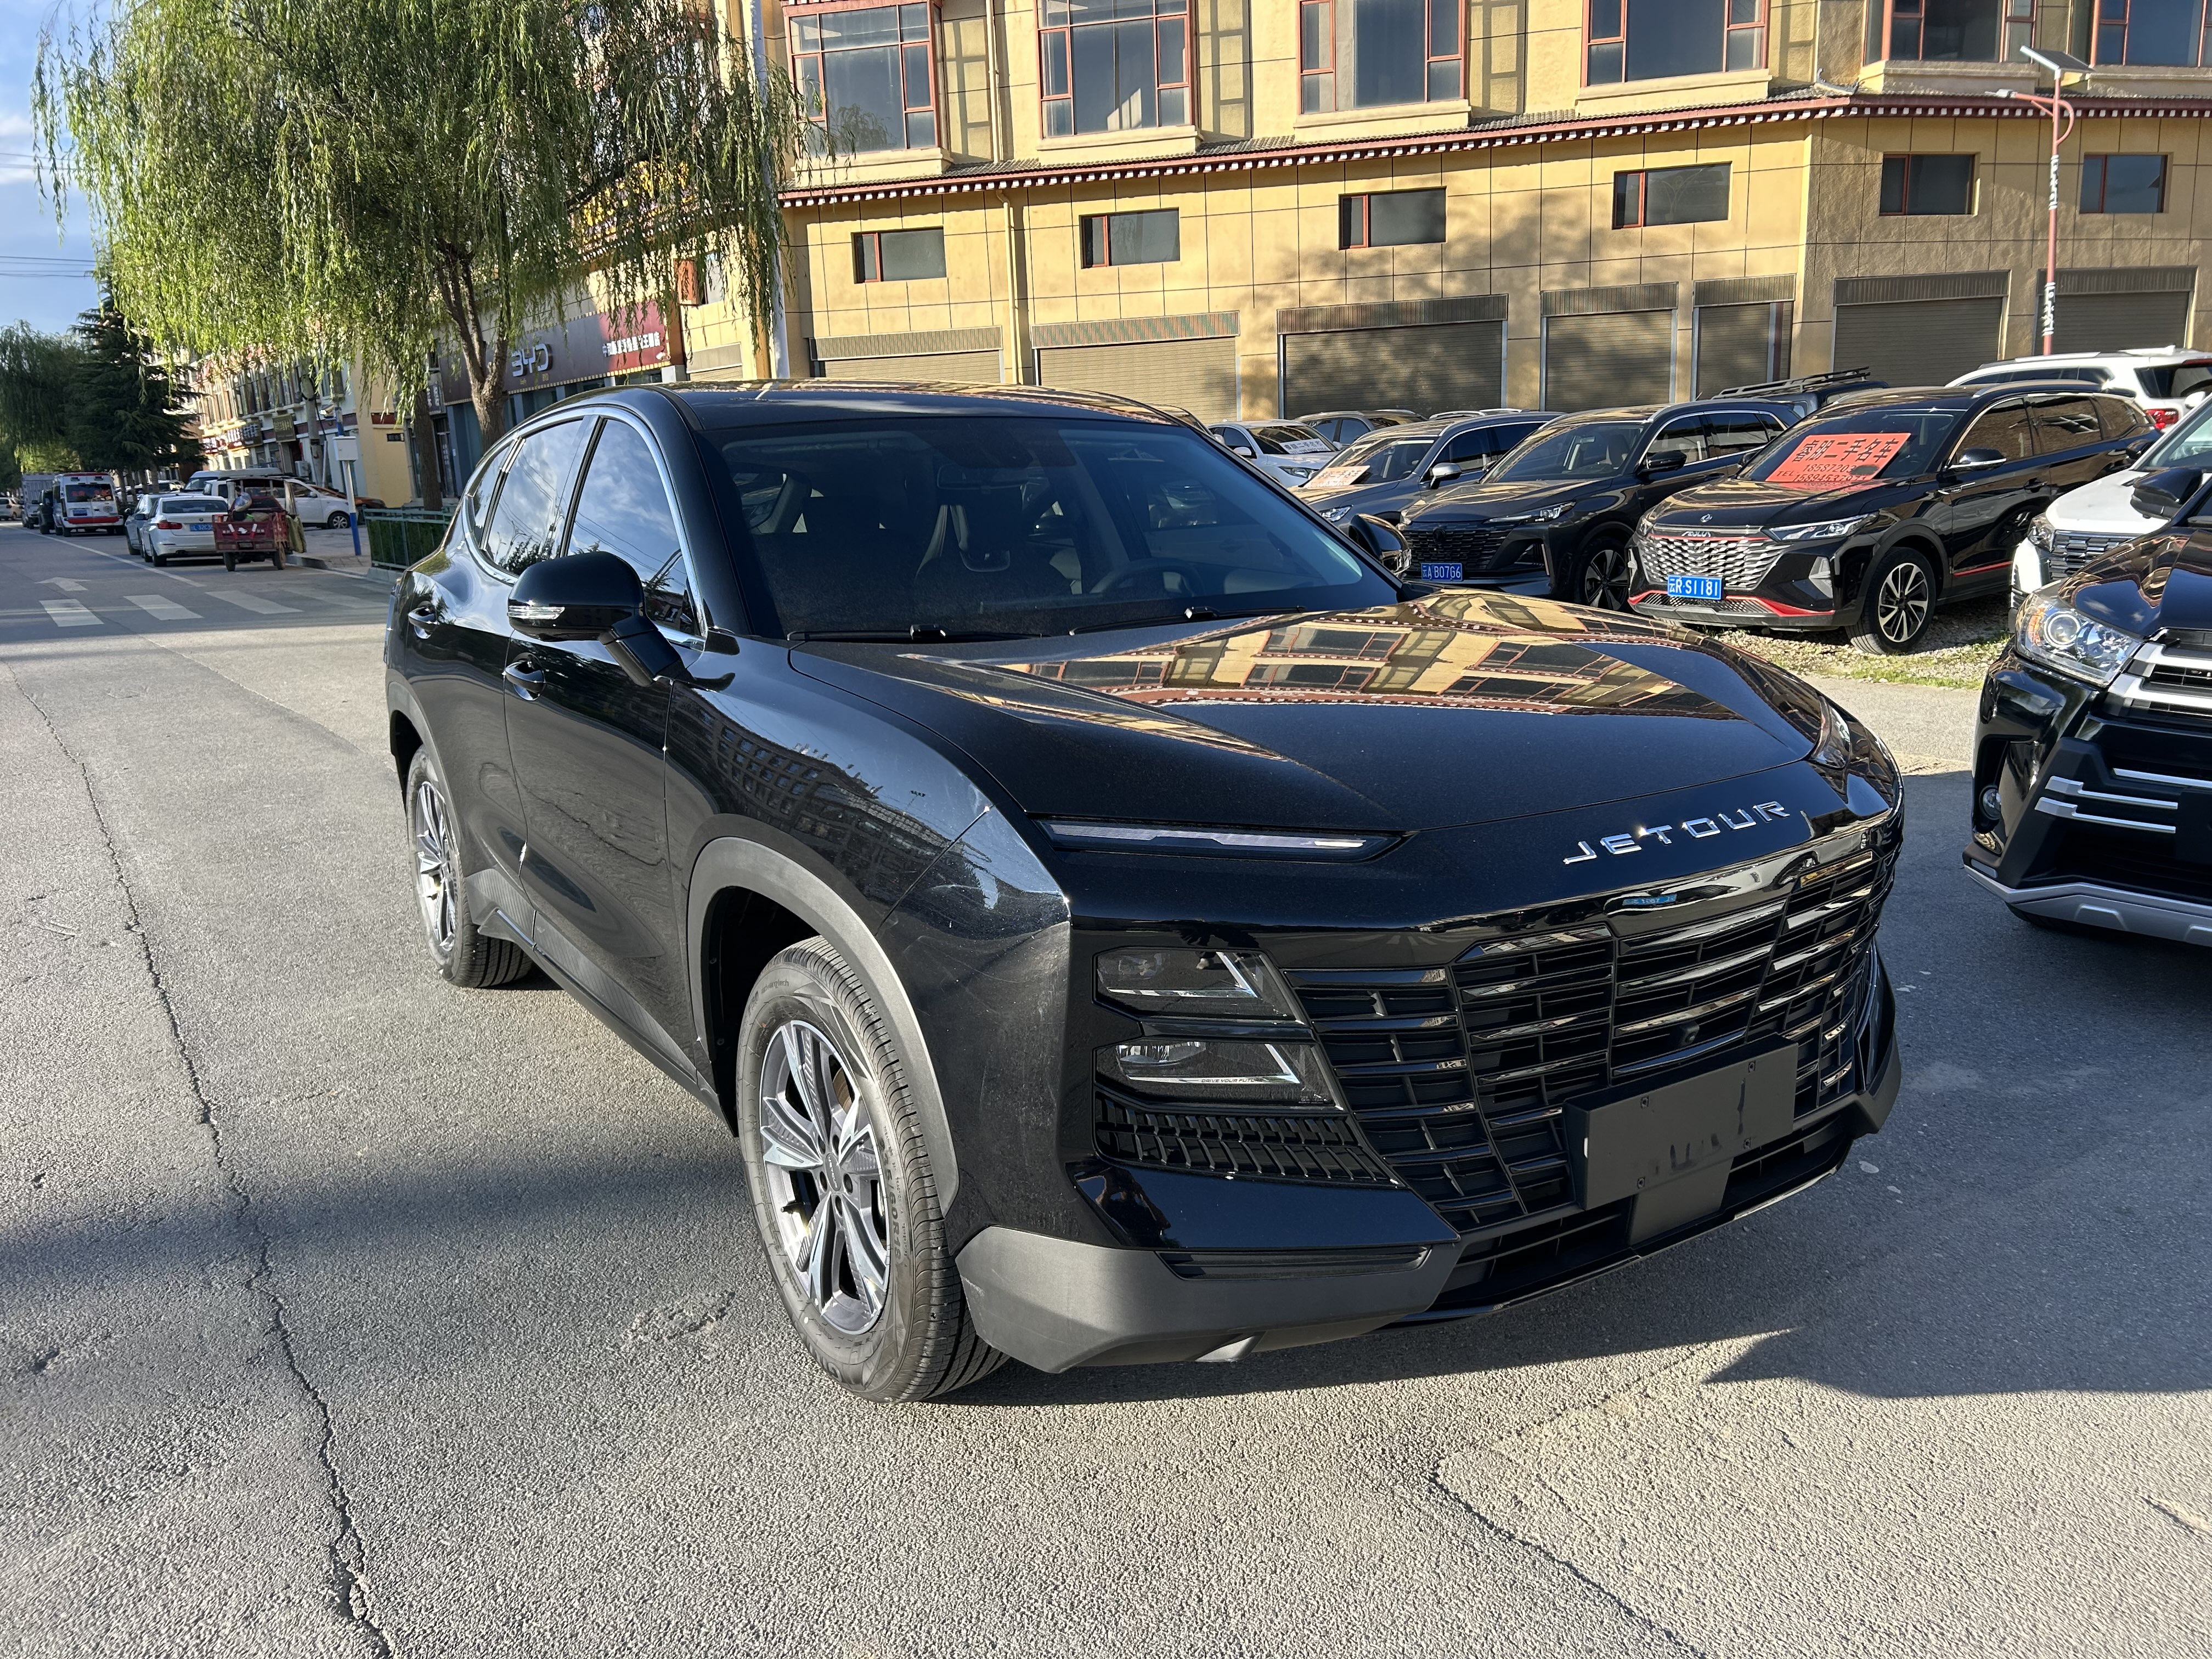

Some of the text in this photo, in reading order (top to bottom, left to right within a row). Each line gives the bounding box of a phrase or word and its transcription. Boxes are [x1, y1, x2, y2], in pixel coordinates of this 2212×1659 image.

[1792, 438, 1899, 463] 睿朋二手名车
[1803, 464, 1861, 476] 18587203
[1562, 800, 1791, 865] JETOUR
[879, 1137, 902, 1260] 235/60R18
